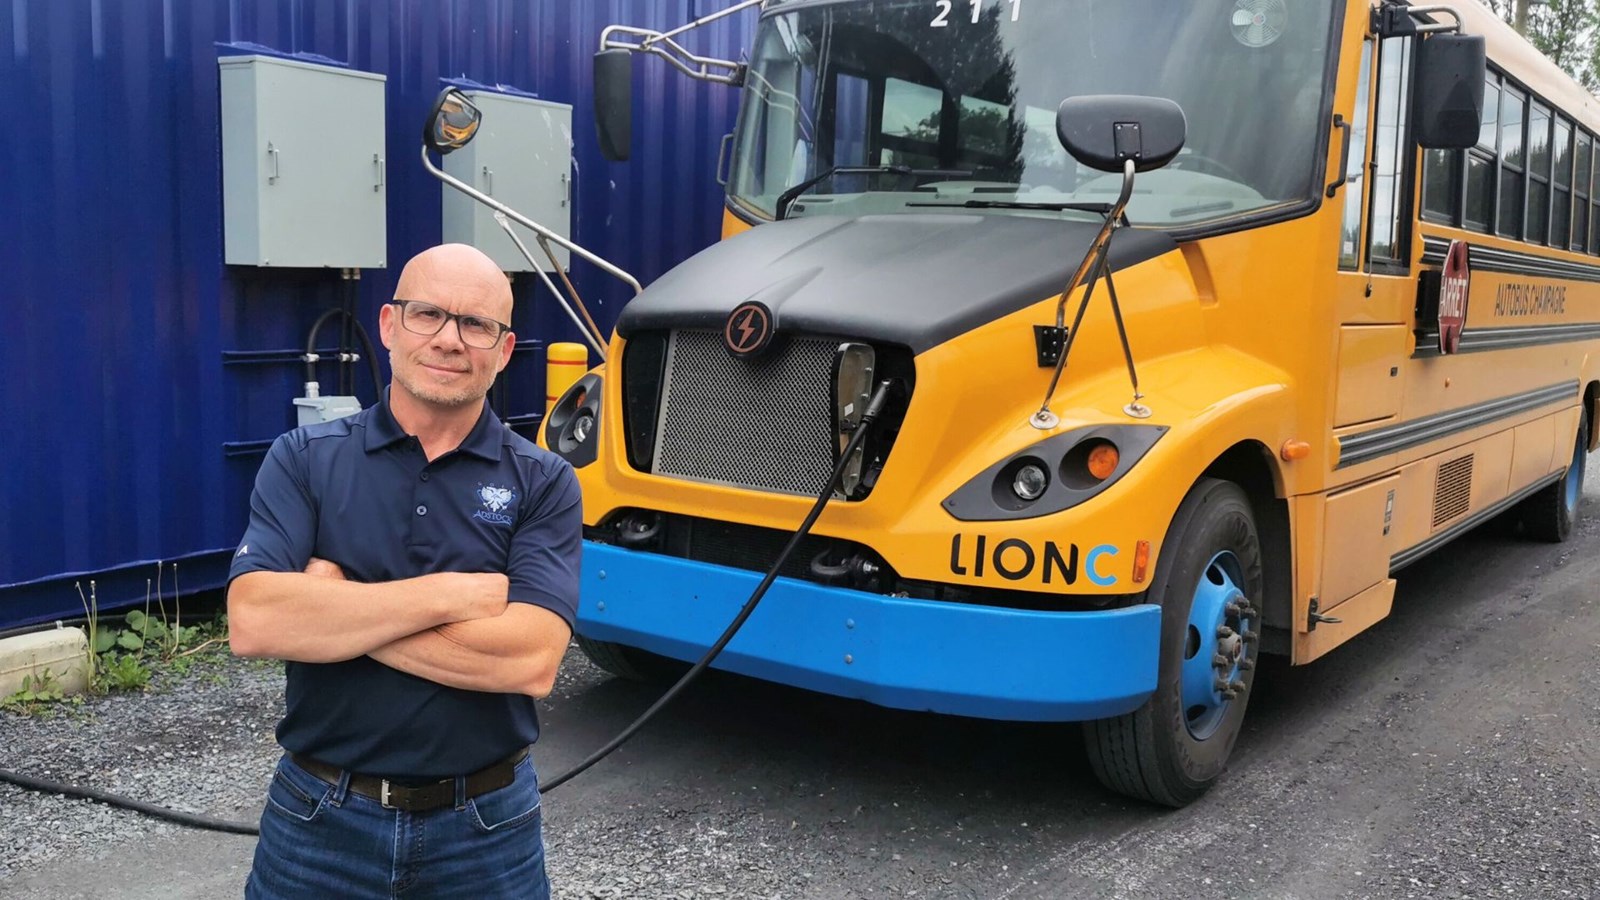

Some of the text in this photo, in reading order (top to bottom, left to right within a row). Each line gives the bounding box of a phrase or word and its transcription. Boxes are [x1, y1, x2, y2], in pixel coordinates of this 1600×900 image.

[1439, 273, 1467, 318] ARRÊT
[1494, 283, 1566, 316] AUTOBUS CHAMPAGNE
